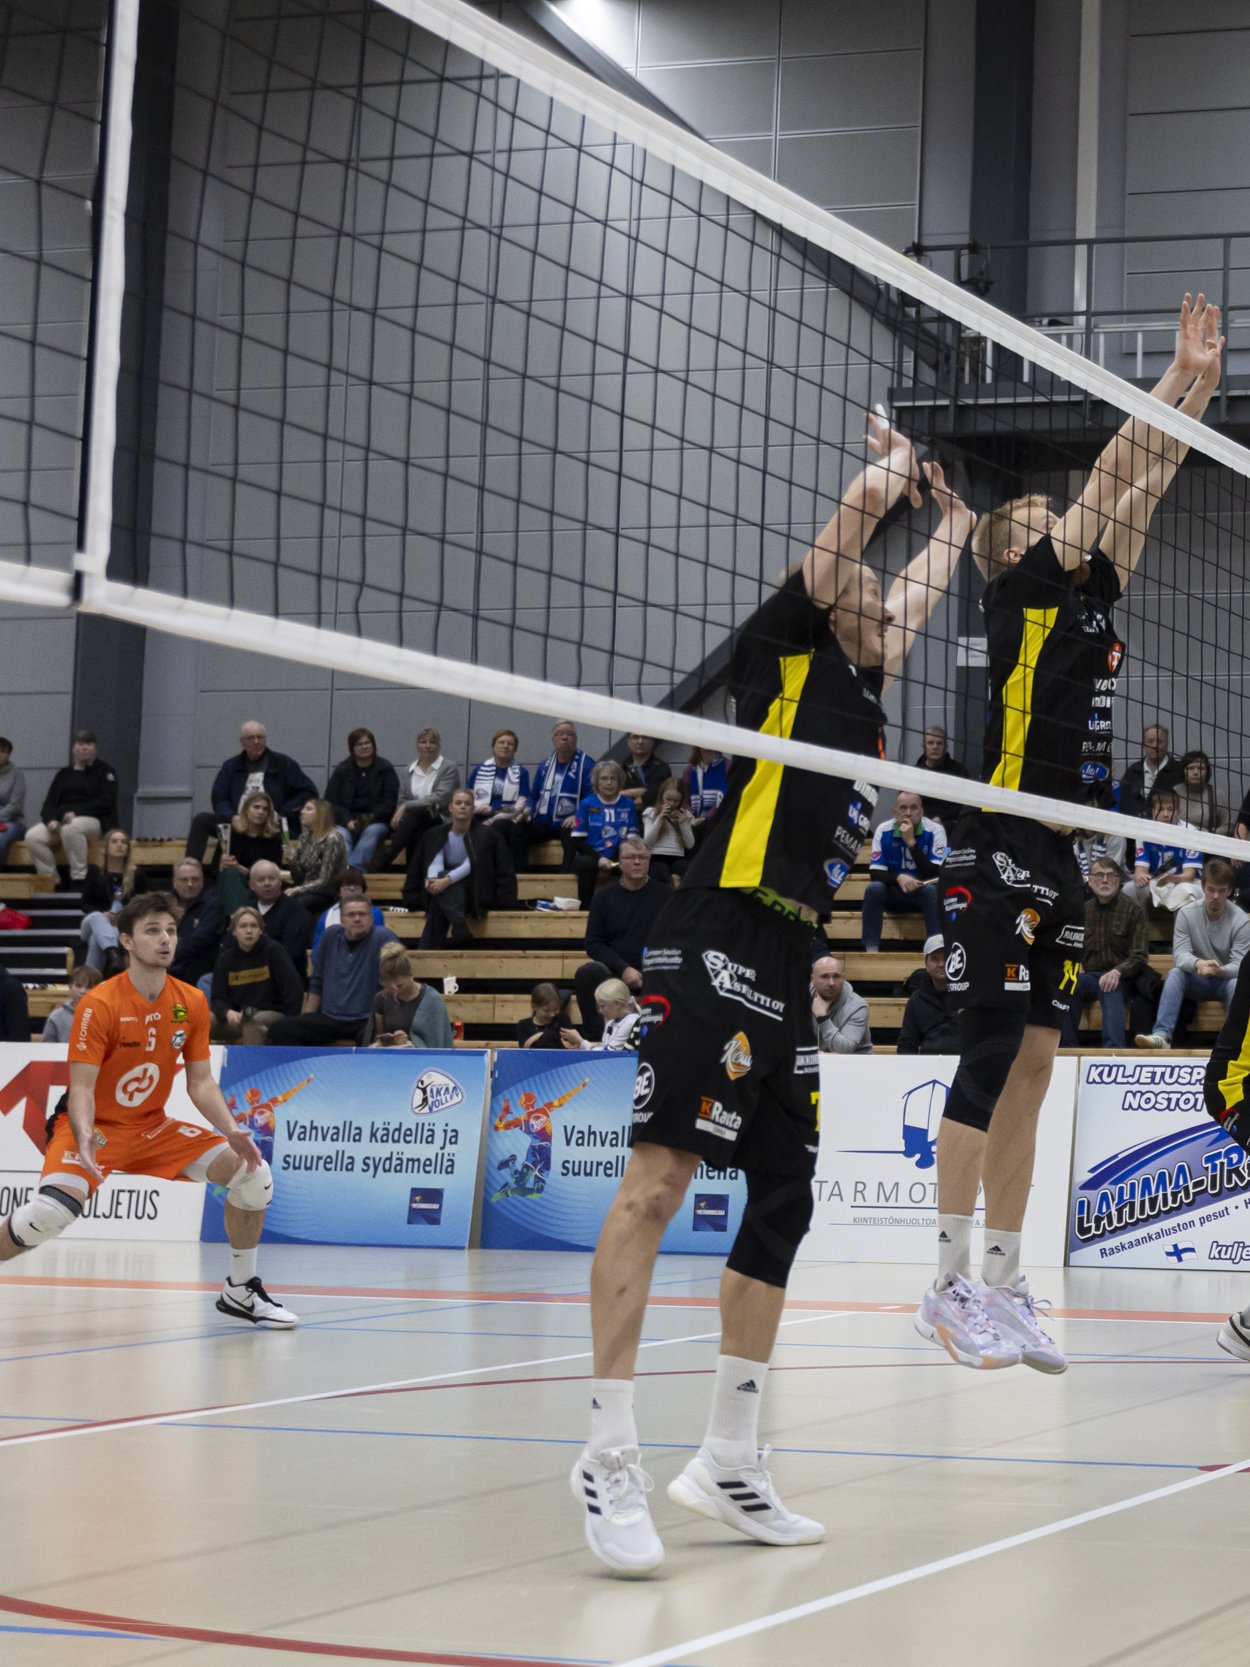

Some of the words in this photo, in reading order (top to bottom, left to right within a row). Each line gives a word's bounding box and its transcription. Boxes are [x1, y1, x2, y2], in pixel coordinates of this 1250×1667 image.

[145, 1027, 157, 1052] 6
[1087, 1064, 1206, 1086] KULJETUSP
[428, 1092, 460, 1114] VOLLEY
[430, 1085, 458, 1099] AKAA
[286, 1119, 363, 1143] Vahvalla
[369, 1120, 436, 1146] kädellä
[440, 1123, 459, 1150] ja
[563, 1124, 632, 1148] Vahvall
[282, 1150, 356, 1173] suurella
[361, 1150, 456, 1179] sydämellä
[560, 1155, 626, 1178] suurell
[80, 1188, 160, 1220] ULJETUS
[1099, 1218, 1196, 1259] Raskaankaluston
[1199, 1206, 1231, 1227] pesut
